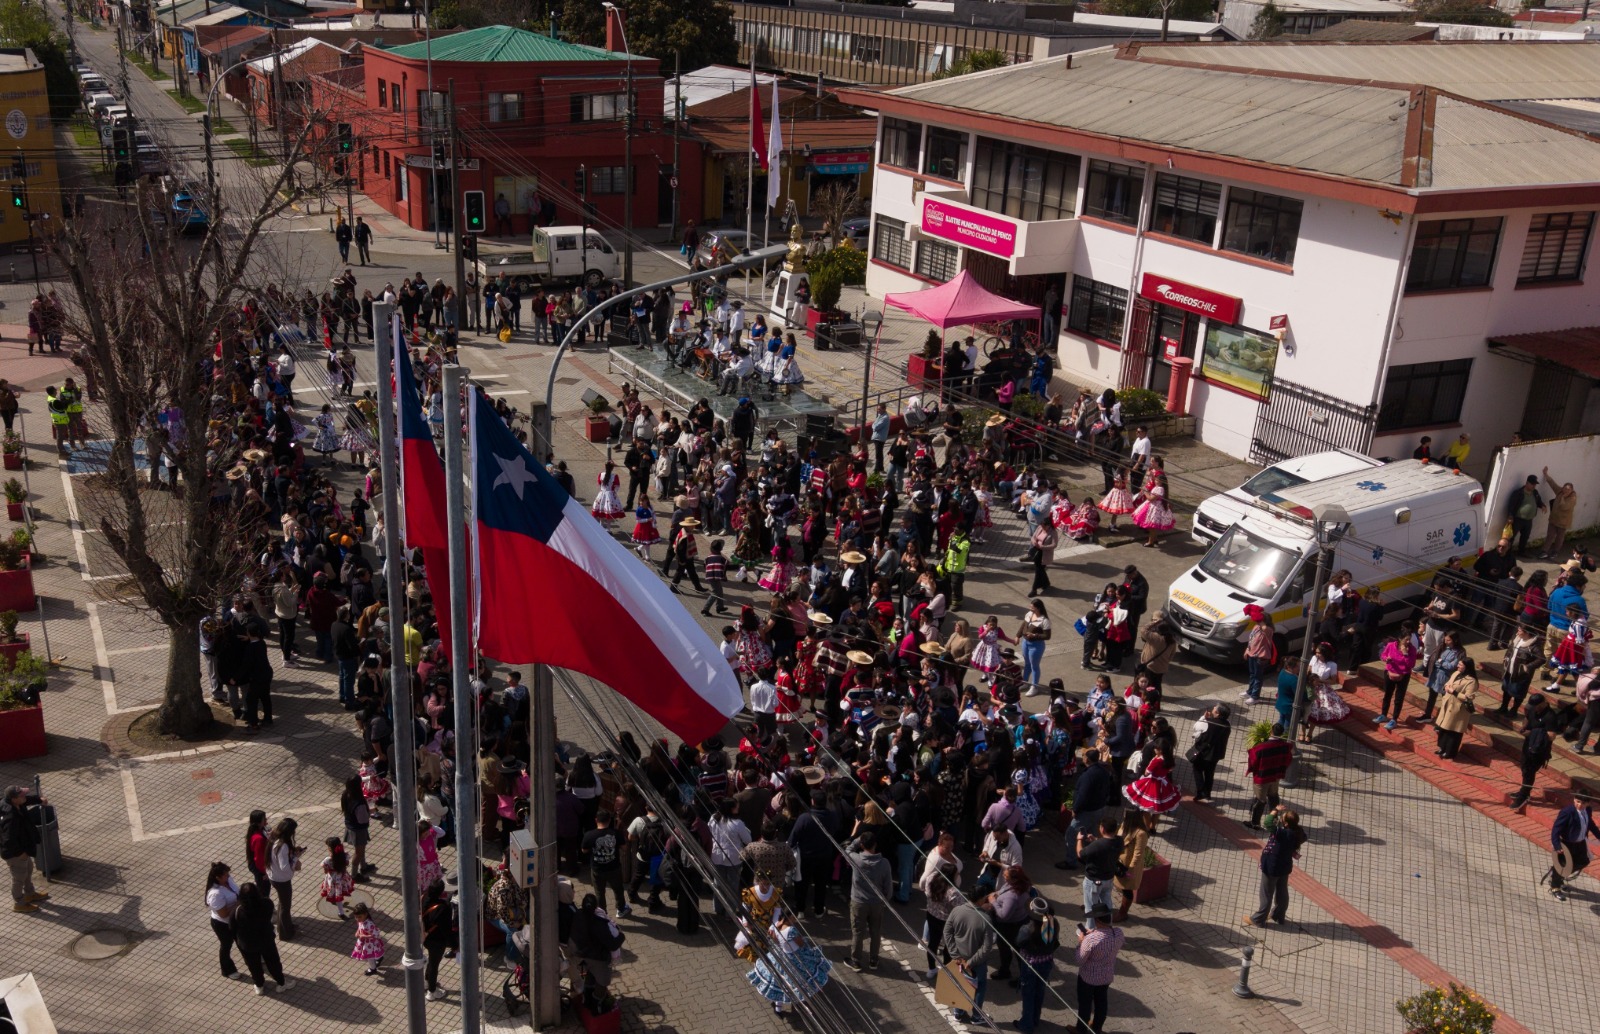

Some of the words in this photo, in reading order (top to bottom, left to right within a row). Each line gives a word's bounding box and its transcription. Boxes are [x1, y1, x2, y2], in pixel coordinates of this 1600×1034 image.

[945, 215, 961, 226] ILUSTRE
[961, 219, 991, 234] MUNICIPALIDAD
[991, 227, 998, 236] DE
[997, 230, 1012, 241] PENCO
[957, 226, 975, 238] MUNICIPIO
[975, 232, 998, 244] CIUDADANO
[1164, 290, 1217, 313] CORREOSCHILE
[1426, 528, 1444, 541] SAR
[1433, 596, 1446, 610] Lee
